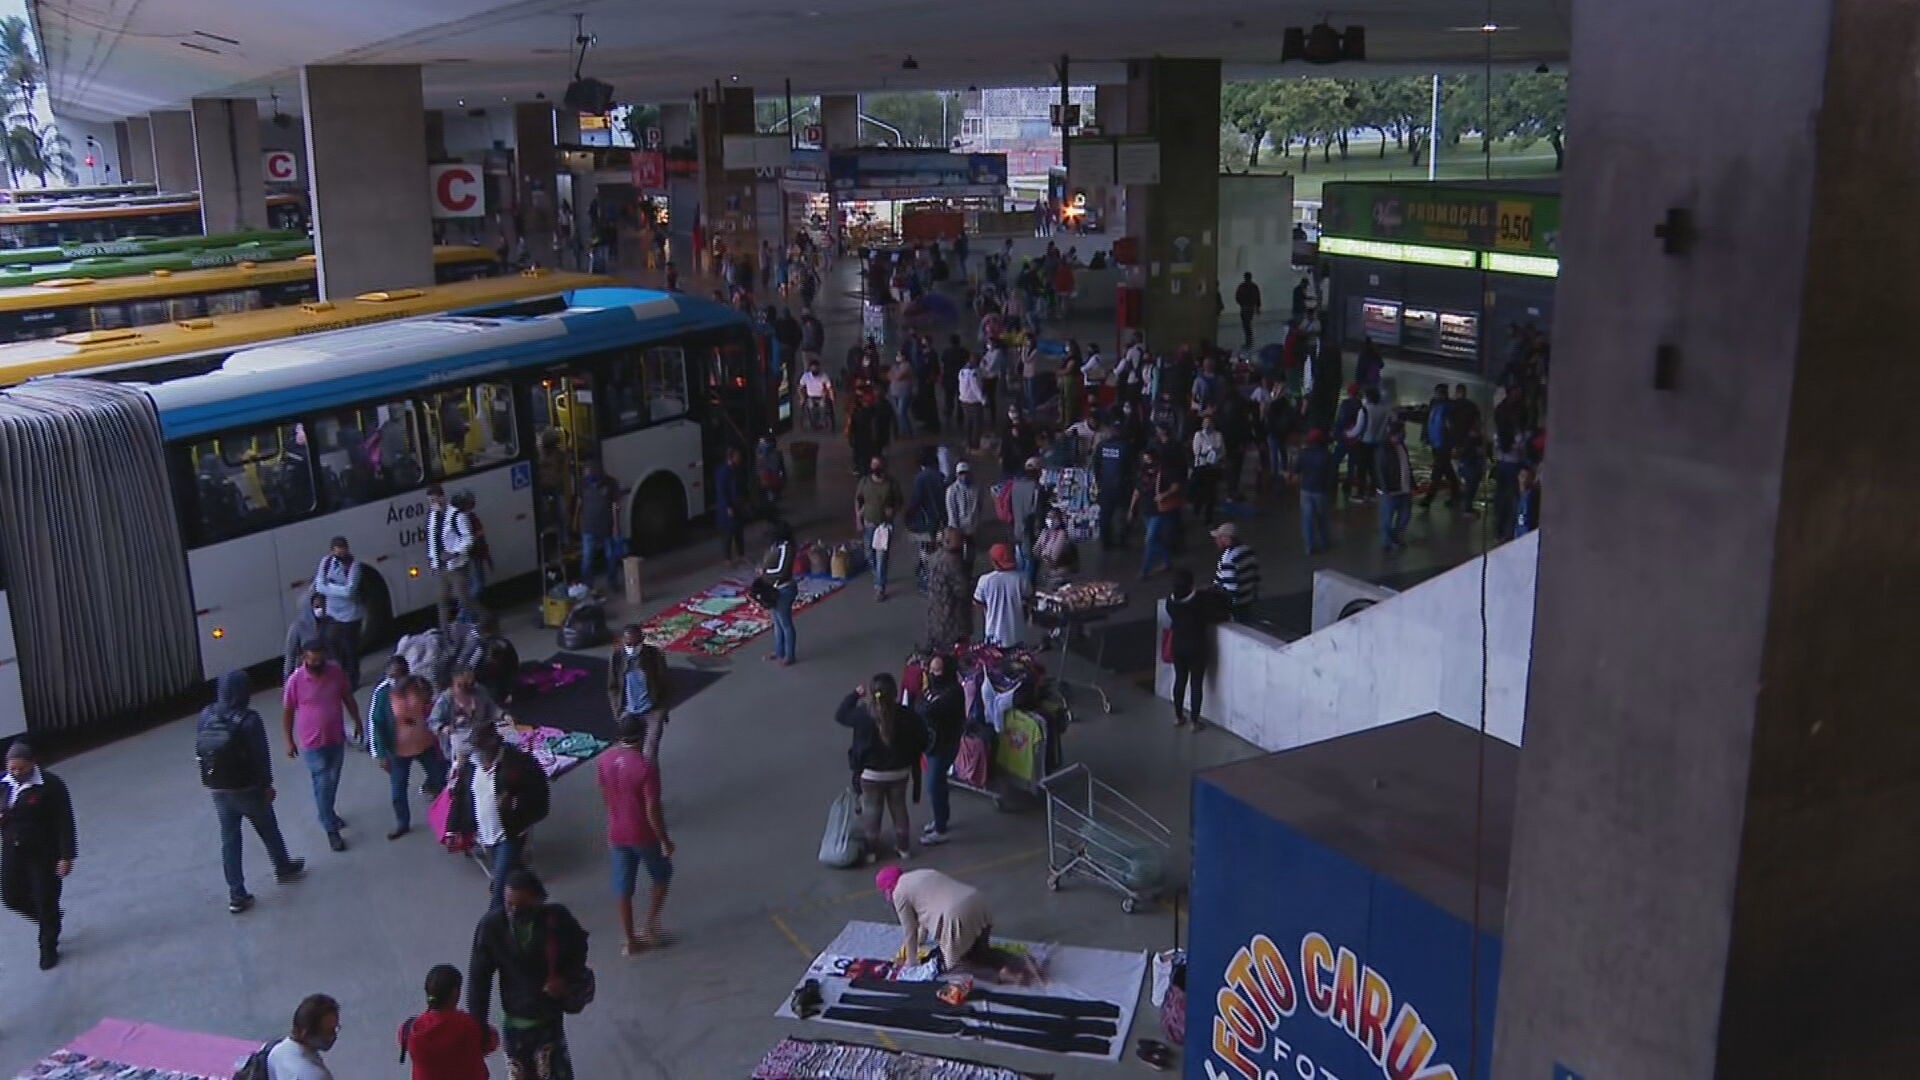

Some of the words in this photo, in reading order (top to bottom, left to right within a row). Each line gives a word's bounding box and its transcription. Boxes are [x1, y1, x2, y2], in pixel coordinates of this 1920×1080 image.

[808, 126, 820, 141] D
[268, 154, 292, 178] C
[437, 169, 477, 212] C
[386, 501, 424, 525] Área
[399, 526, 425, 547] Urb
[1212, 934, 1297, 1080] FOTO
[1300, 932, 1459, 1080] CARU
